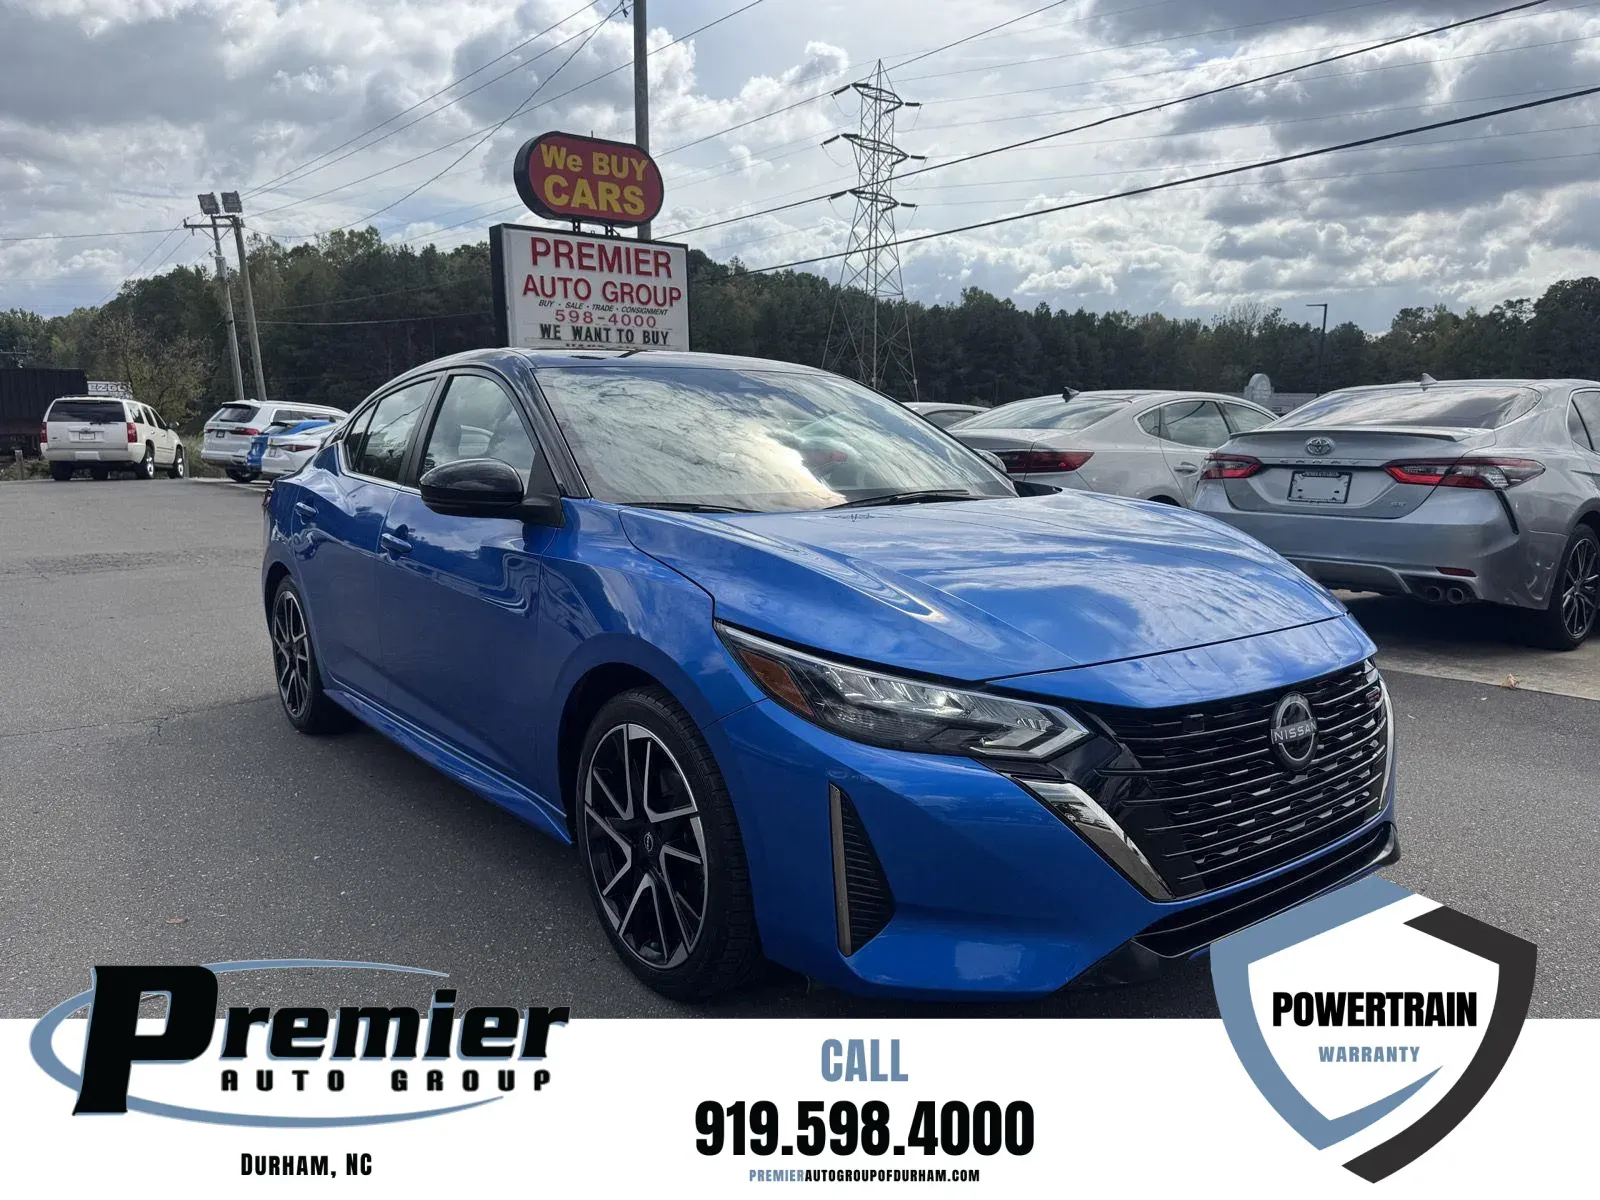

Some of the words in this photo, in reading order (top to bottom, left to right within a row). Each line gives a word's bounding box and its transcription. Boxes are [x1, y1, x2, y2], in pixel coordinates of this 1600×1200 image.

[540, 143, 583, 172] We
[592, 151, 648, 182] BUY
[543, 174, 646, 216] CARS
[530, 236, 672, 279] PREMIER
[522, 274, 592, 301] AUTO
[601, 280, 682, 308] GROUP
[538, 299, 554, 308] BUY
[564, 301, 584, 310] SALE
[591, 303, 614, 312] TRADE
[620, 305, 669, 316] CONSIGNMENT
[554, 309, 657, 328] 598-4000
[539, 323, 562, 340] WE
[571, 325, 611, 342] WANT
[616, 328, 635, 343] TO
[642, 330, 669, 345] BUY
[1273, 721, 1317, 741] NISSAN
